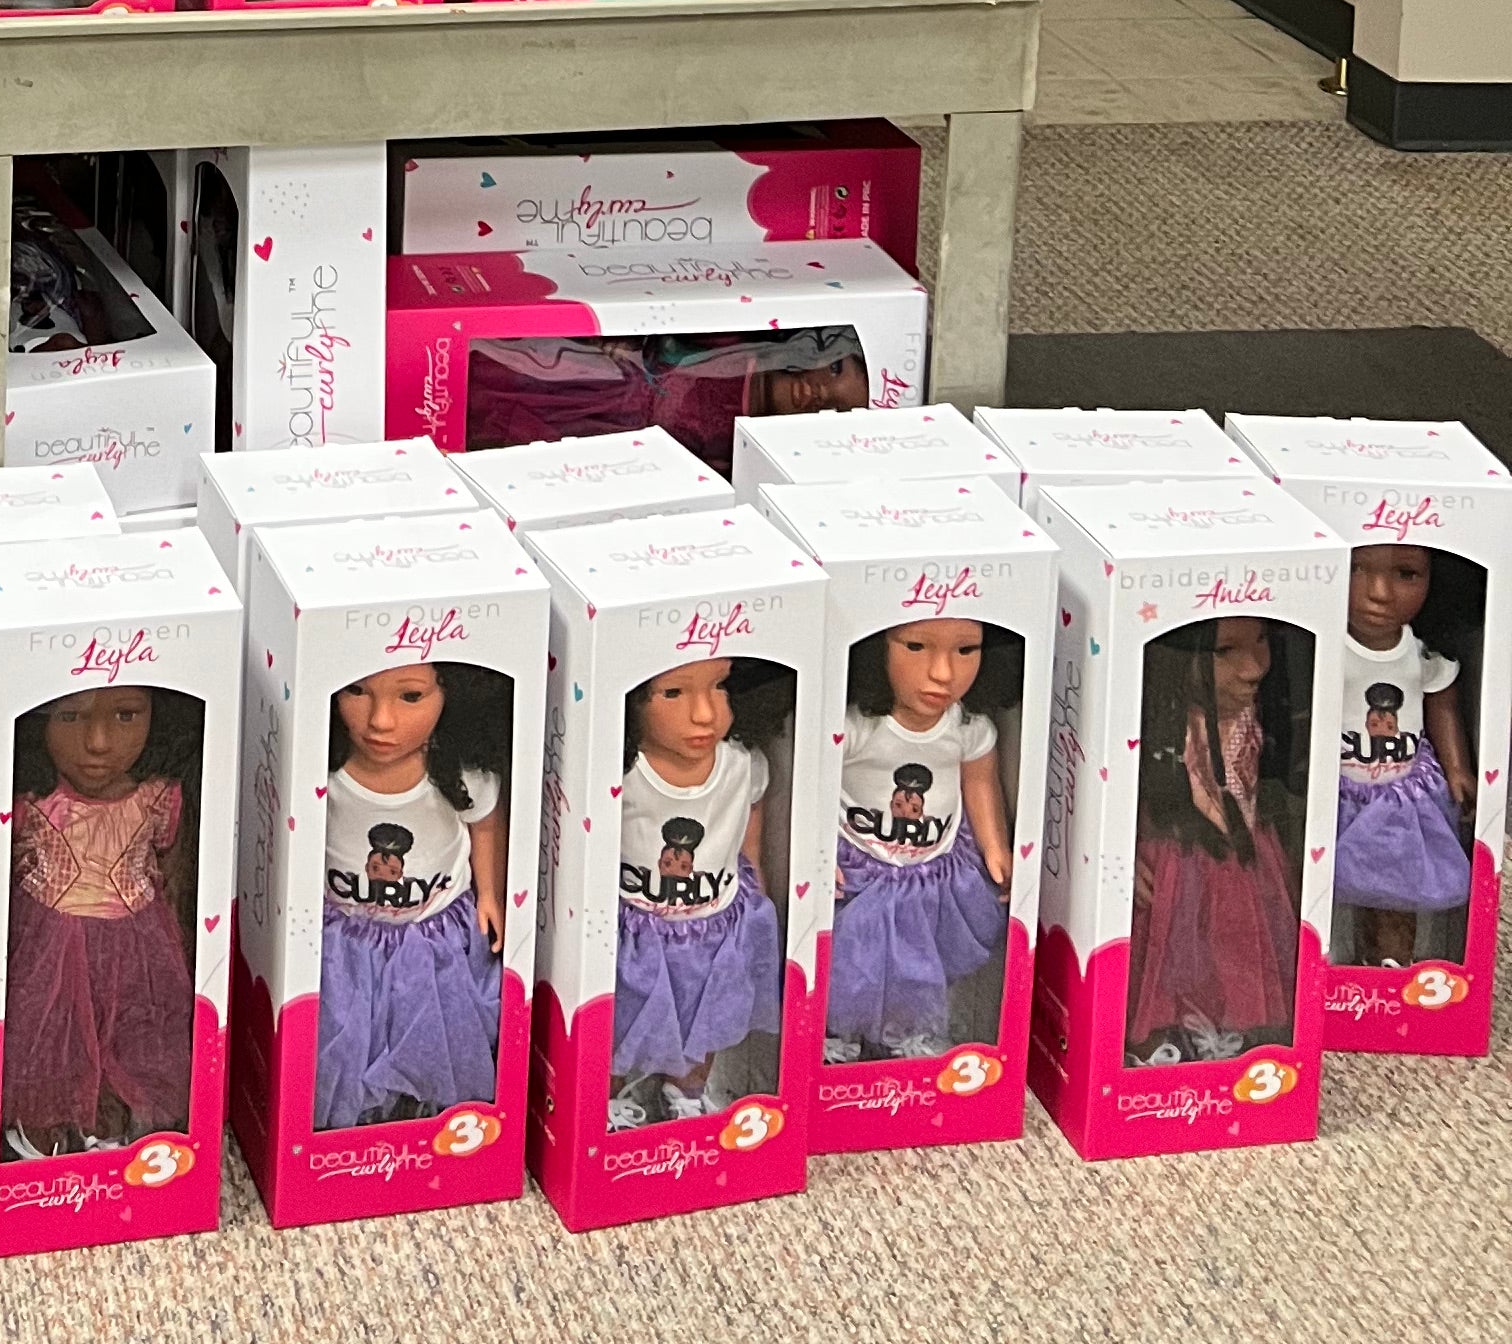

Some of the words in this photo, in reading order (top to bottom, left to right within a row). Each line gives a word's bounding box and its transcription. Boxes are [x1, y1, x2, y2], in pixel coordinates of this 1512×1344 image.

[1323, 486, 1368, 507] Fro
[864, 563, 909, 584] Fro
[346, 609, 390, 630] Fro
[639, 607, 682, 629] Fro
[30, 631, 78, 653] Fro
